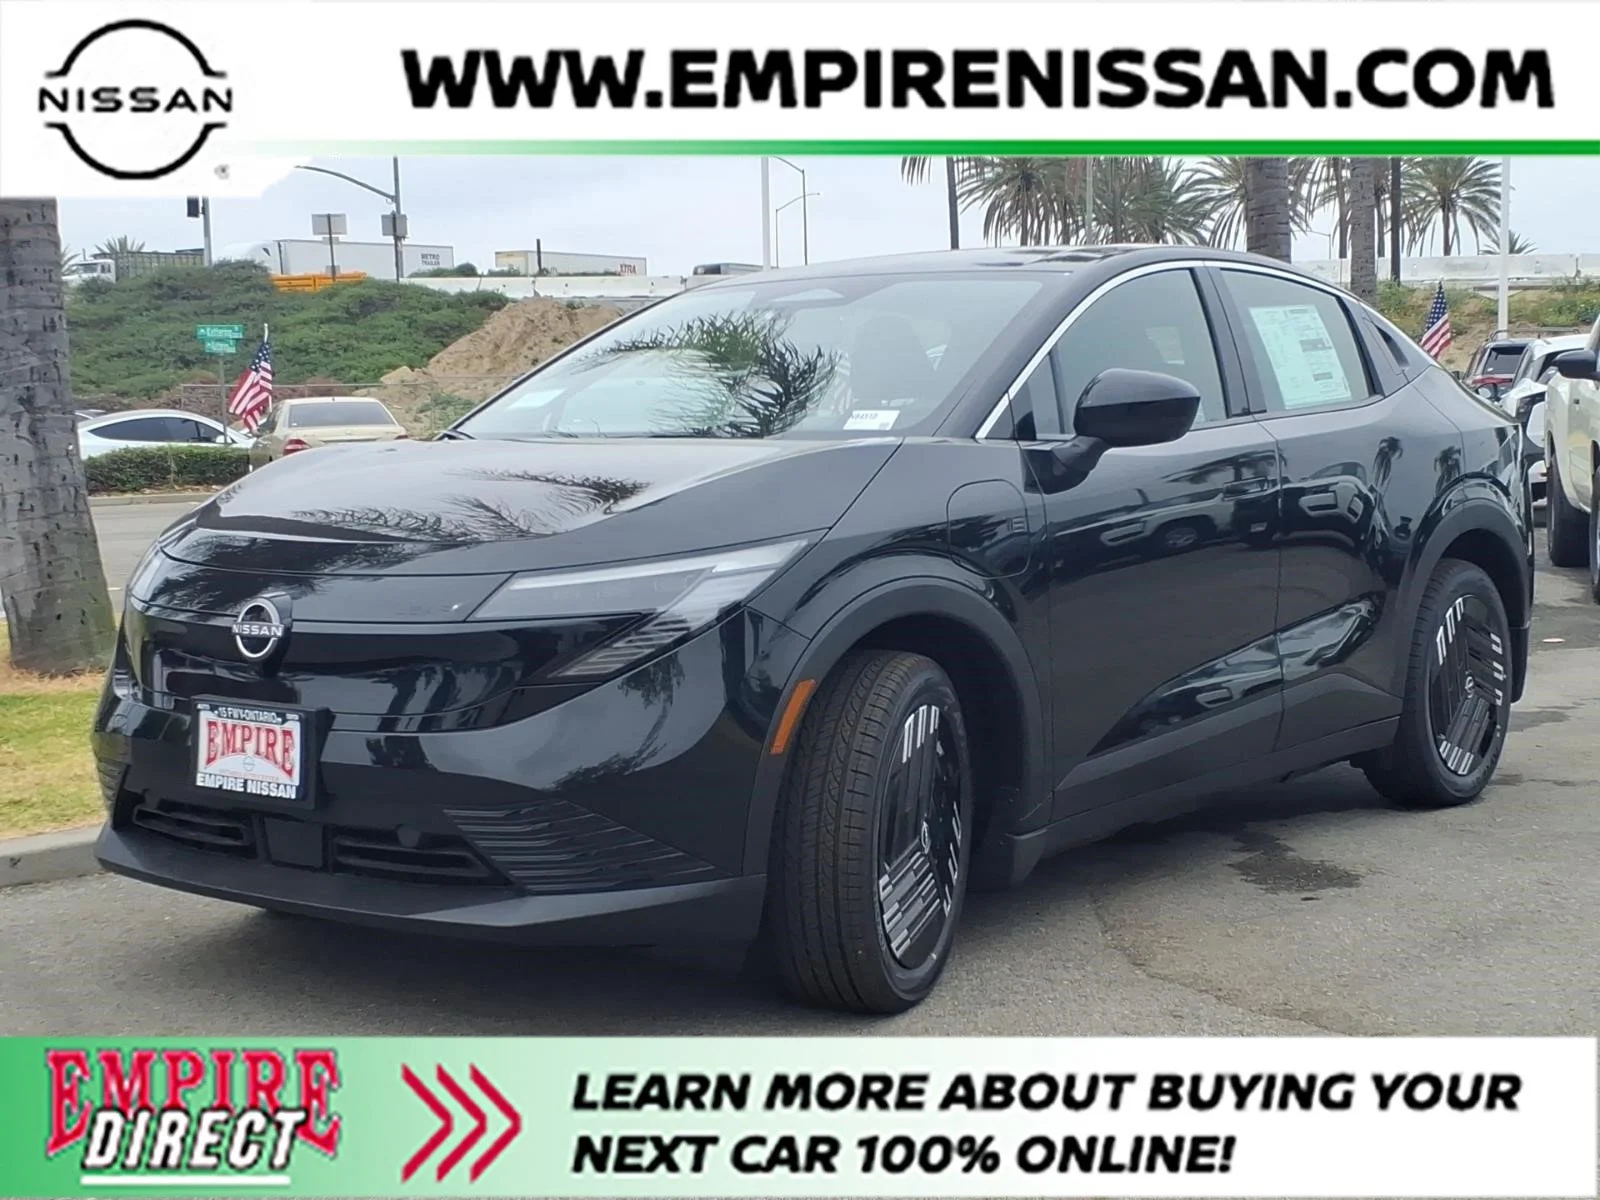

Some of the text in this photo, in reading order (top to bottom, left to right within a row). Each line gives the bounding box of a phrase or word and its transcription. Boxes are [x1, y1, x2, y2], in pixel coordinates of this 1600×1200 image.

[232, 623, 284, 637] NISSAN
[205, 720, 296, 779] EMPIRE
[196, 773, 244, 792] EMPIRE
[246, 779, 297, 800] NISSAN
